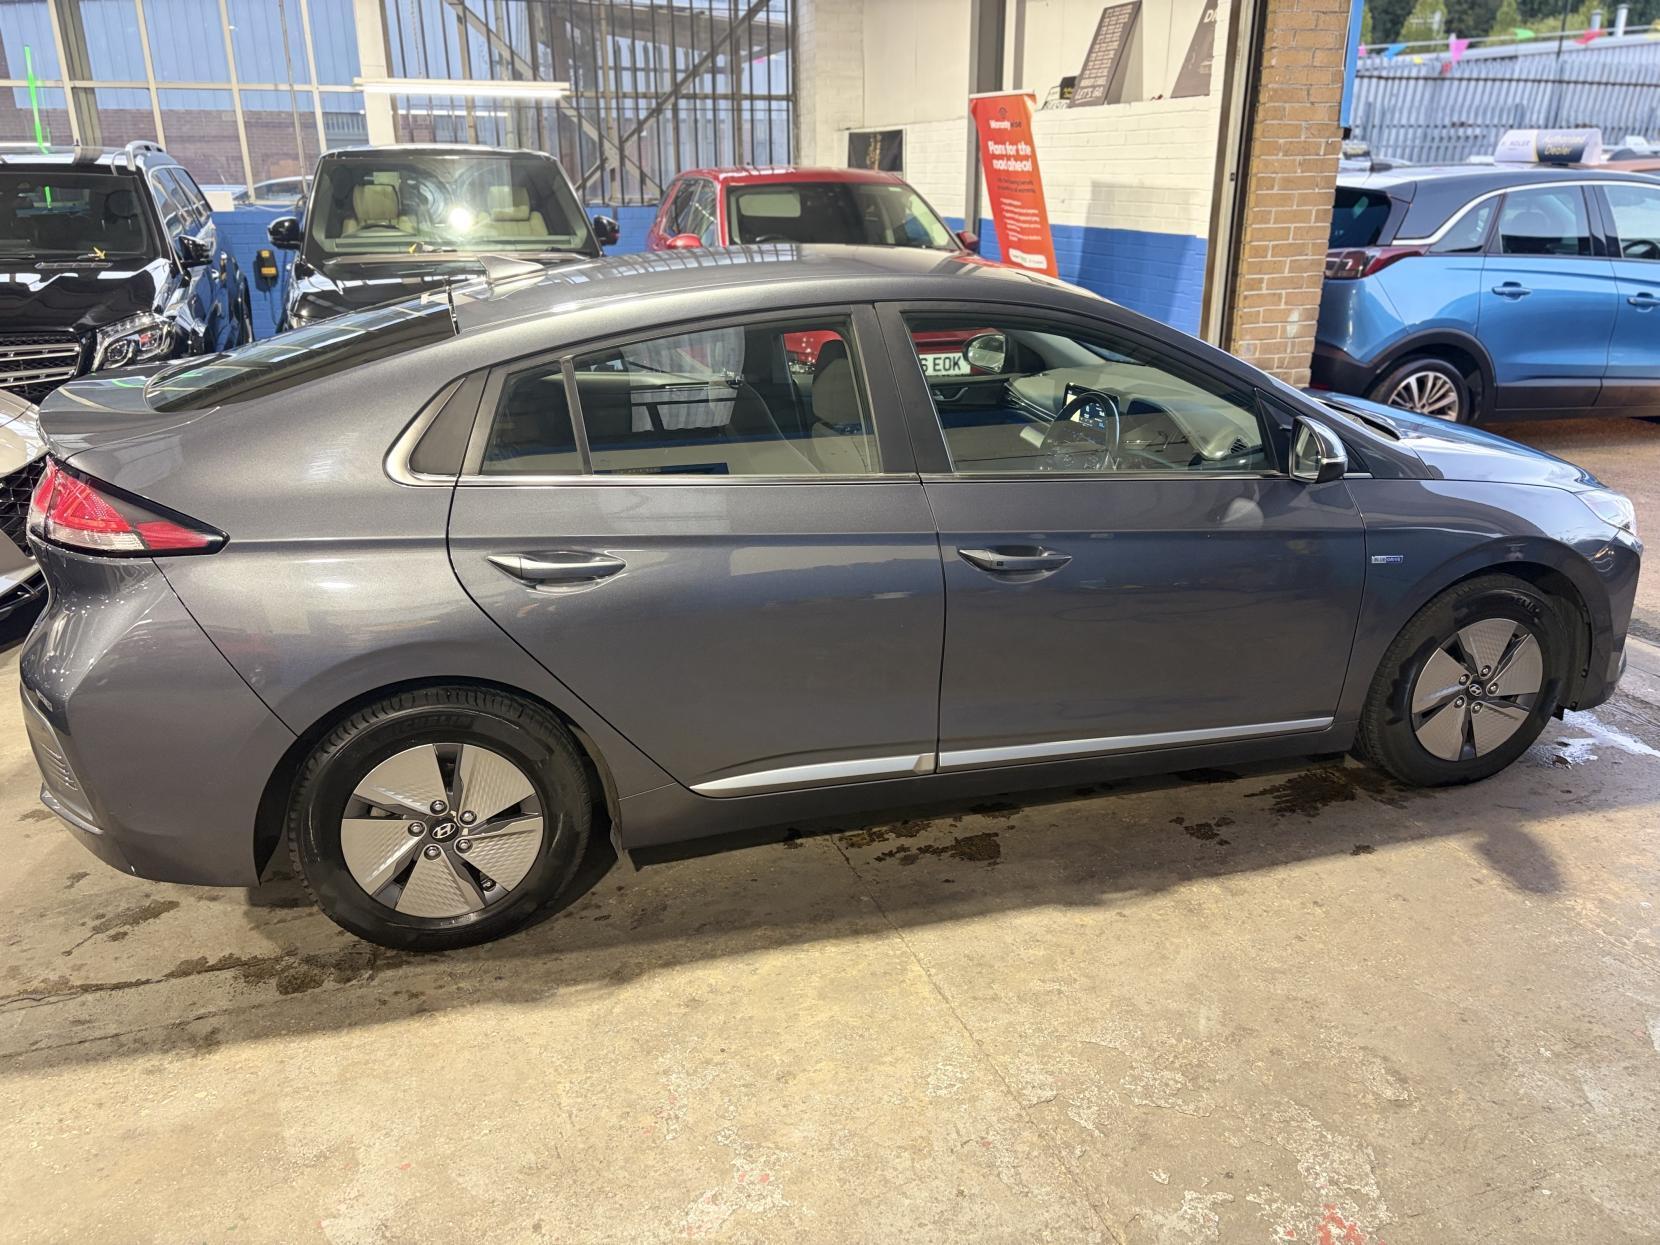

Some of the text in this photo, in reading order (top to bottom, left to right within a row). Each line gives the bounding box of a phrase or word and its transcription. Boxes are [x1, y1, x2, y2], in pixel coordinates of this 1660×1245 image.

[988, 140, 1032, 155] Plans for the
[1007, 158, 1032, 171] ahead
[932, 355, 961, 372] EOK
